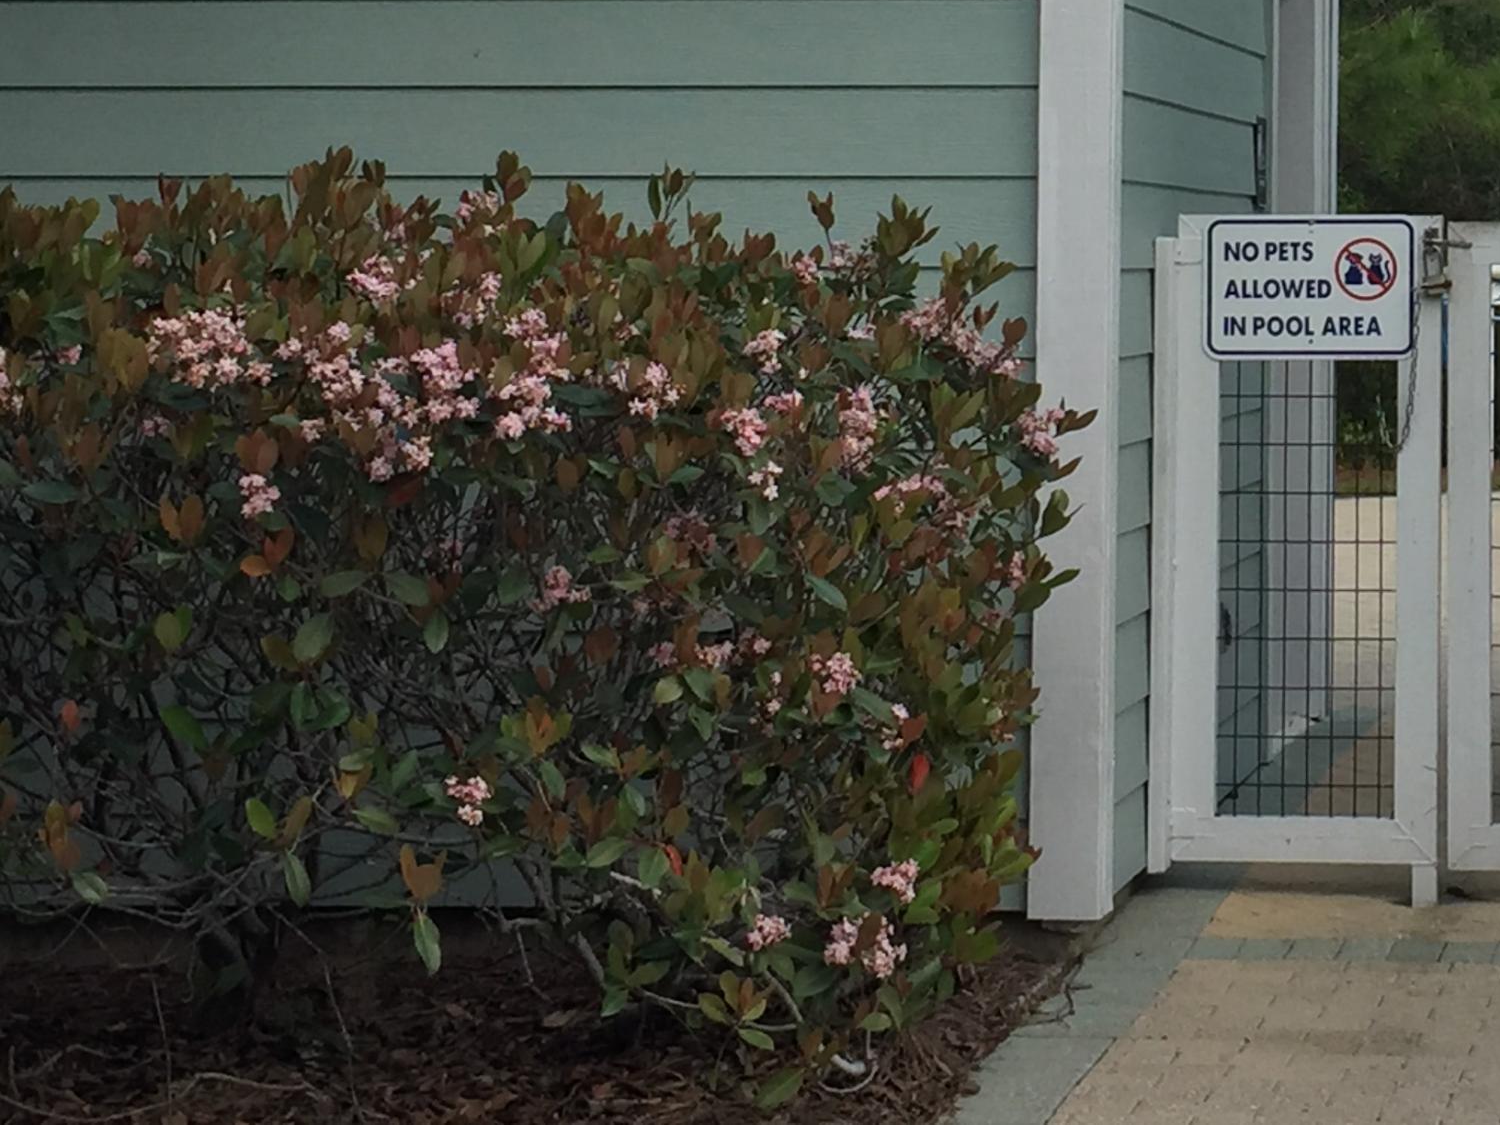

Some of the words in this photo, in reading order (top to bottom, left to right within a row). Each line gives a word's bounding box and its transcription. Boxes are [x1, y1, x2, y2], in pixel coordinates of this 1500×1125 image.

[1224, 241, 1259, 262] NO
[1265, 241, 1314, 262] PETS
[1224, 279, 1332, 300] ALLOWED
[1223, 316, 1246, 336] IN
[1252, 316, 1315, 337] POOL
[1321, 316, 1382, 336] AREA
